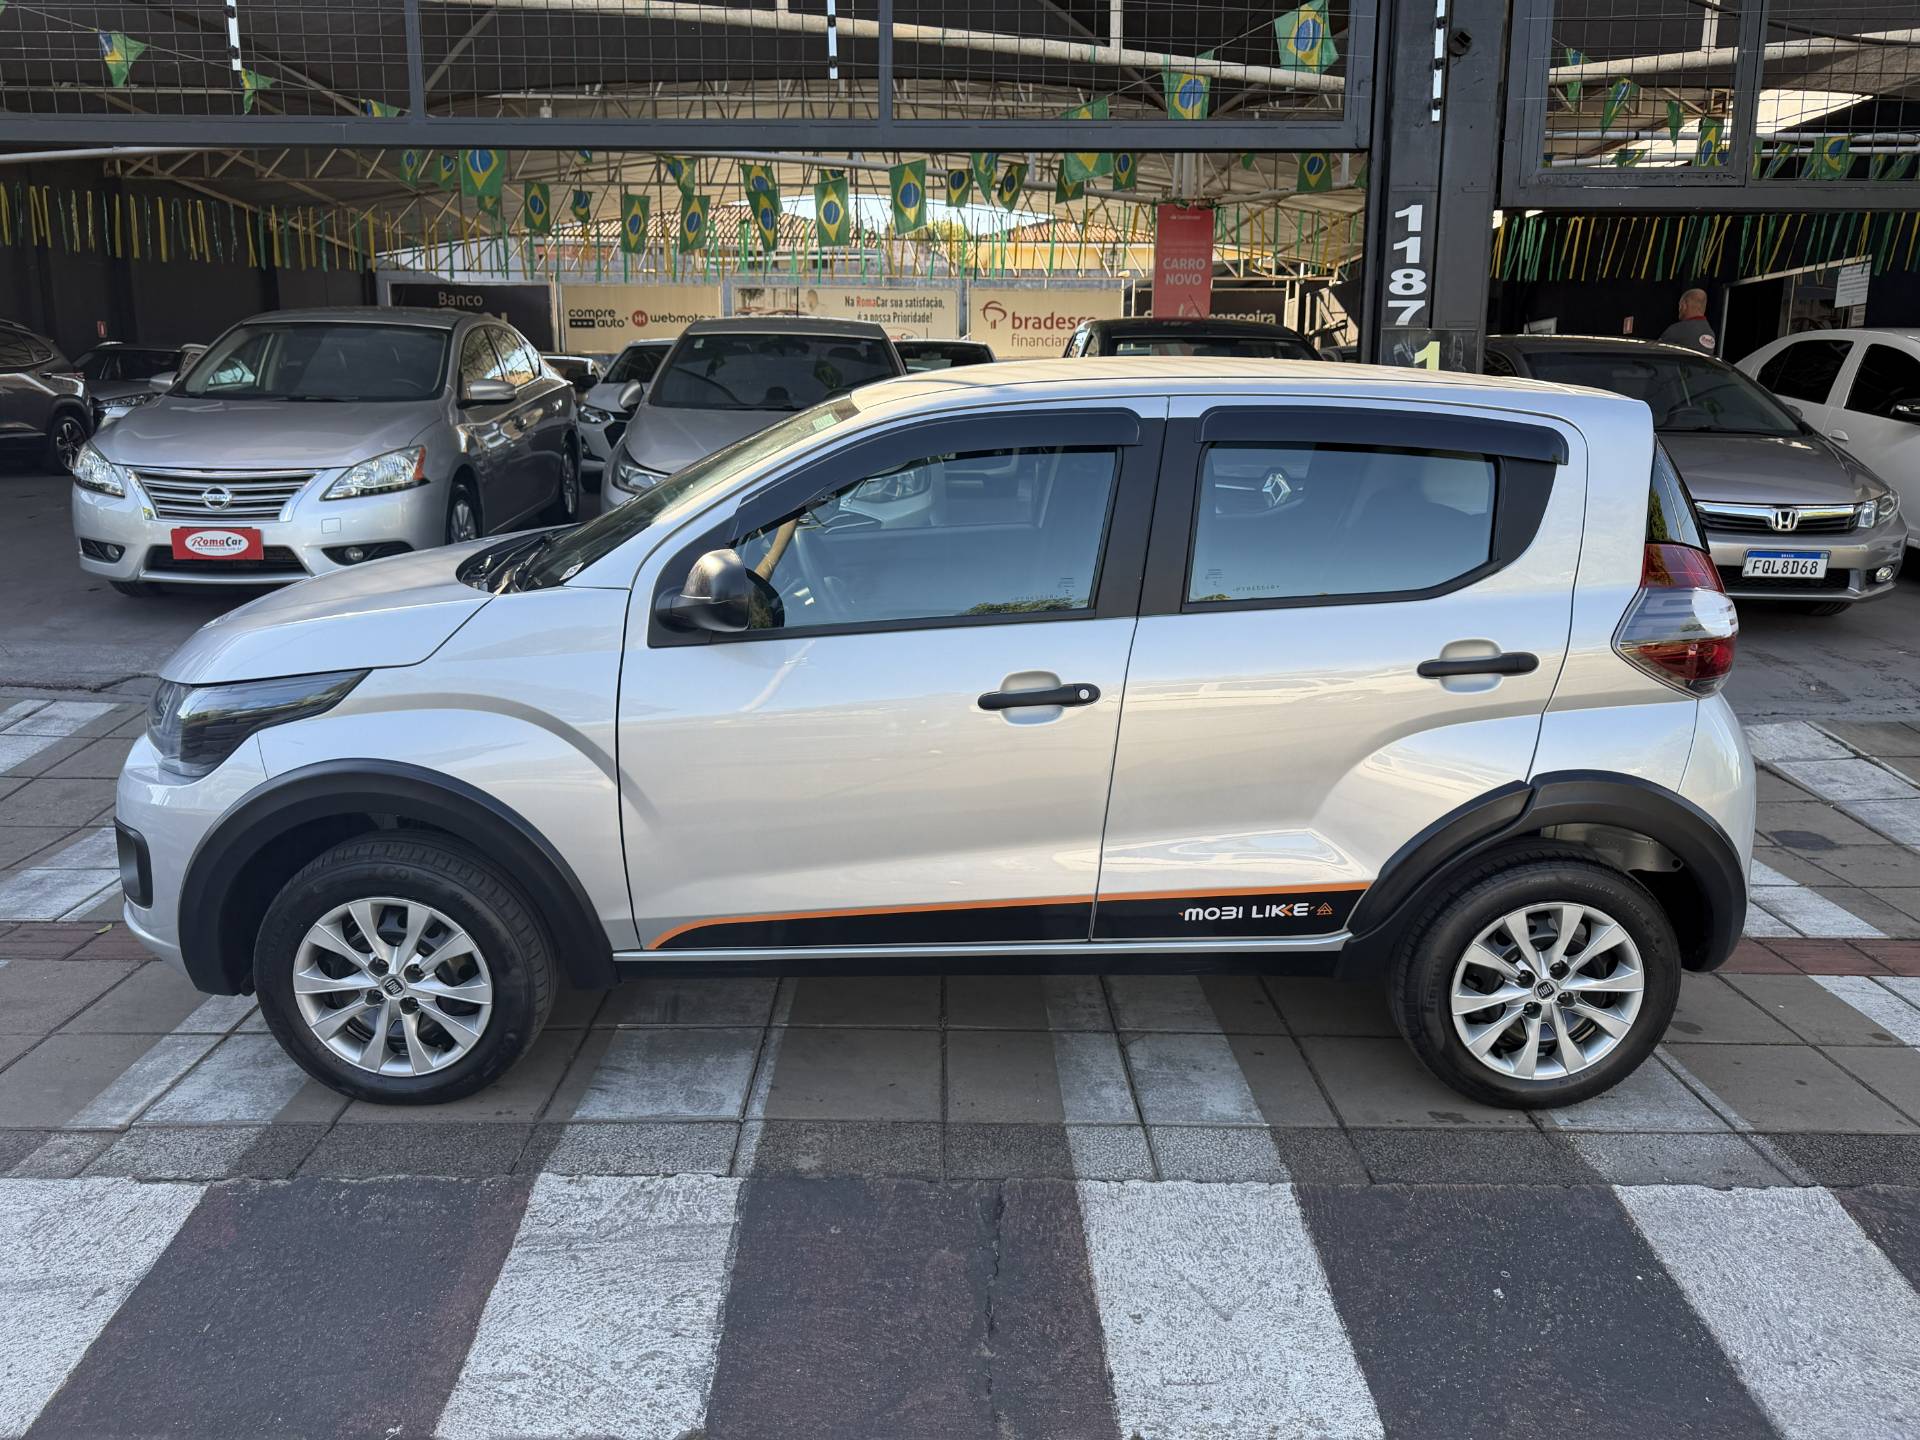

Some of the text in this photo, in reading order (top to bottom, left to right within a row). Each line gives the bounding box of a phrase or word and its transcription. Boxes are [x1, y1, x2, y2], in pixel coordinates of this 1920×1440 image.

[1163, 257, 1206, 270] CARRO
[1388, 204, 1427, 326] 1187
[1166, 273, 1202, 286] NOVO
[438, 291, 483, 306] Banco
[844, 296, 855, 307] Na
[856, 296, 887, 308] RomaCar
[890, 299, 903, 308] sua
[568, 308, 616, 322] compre
[650, 312, 716, 323] webmot
[870, 313, 891, 323] nossa
[893, 311, 933, 323] Prioridade!
[1011, 312, 1096, 330] brades
[597, 318, 625, 328] auto
[1011, 333, 1070, 348] financia
[191, 536, 243, 547] RomaCar
[1751, 560, 1819, 575] FQL8D68
[1184, 902, 1310, 921] MOBI LIKE
